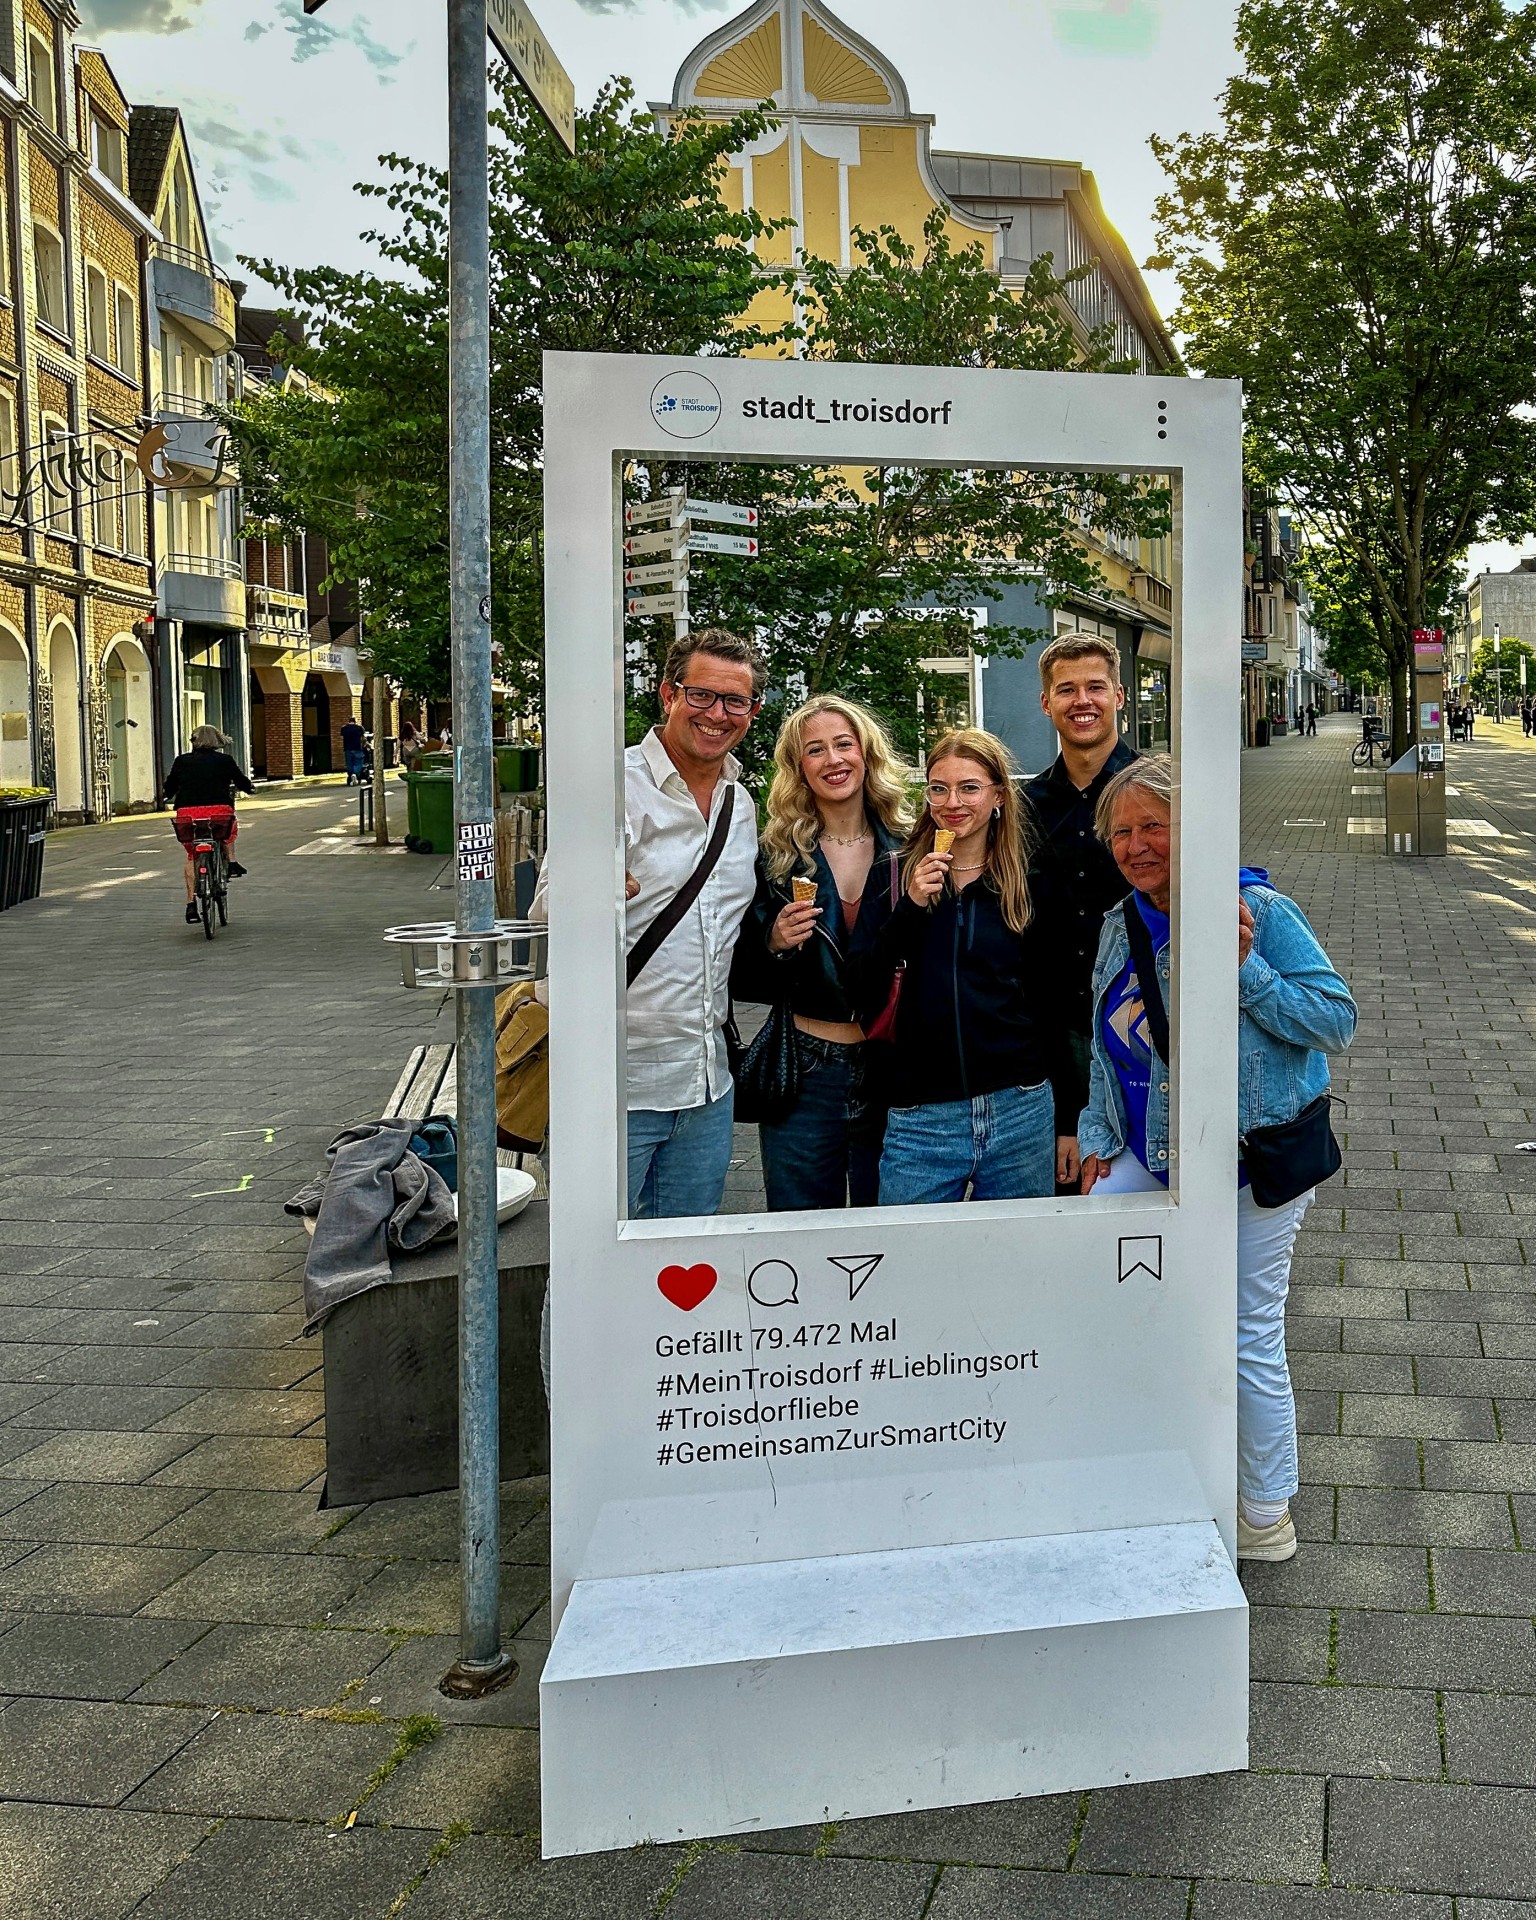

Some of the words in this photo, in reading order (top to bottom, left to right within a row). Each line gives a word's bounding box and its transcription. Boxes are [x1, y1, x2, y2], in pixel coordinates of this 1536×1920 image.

[681, 404, 719, 412] TROISDORF
[742, 394, 953, 425] stadt_troisdorf
[683, 505, 709, 514] Bibliothek
[656, 1330, 744, 1358] Gefällt
[751, 1323, 841, 1350] 79.472
[851, 1318, 897, 1344] Mal
[656, 1359, 863, 1397] #MeinTroisdorf
[869, 1349, 1040, 1381] #Lieblingsort
[656, 1396, 860, 1432] #Troisdorfliebe
[656, 1418, 1008, 1466] #GemeinsamZurSmartCity
